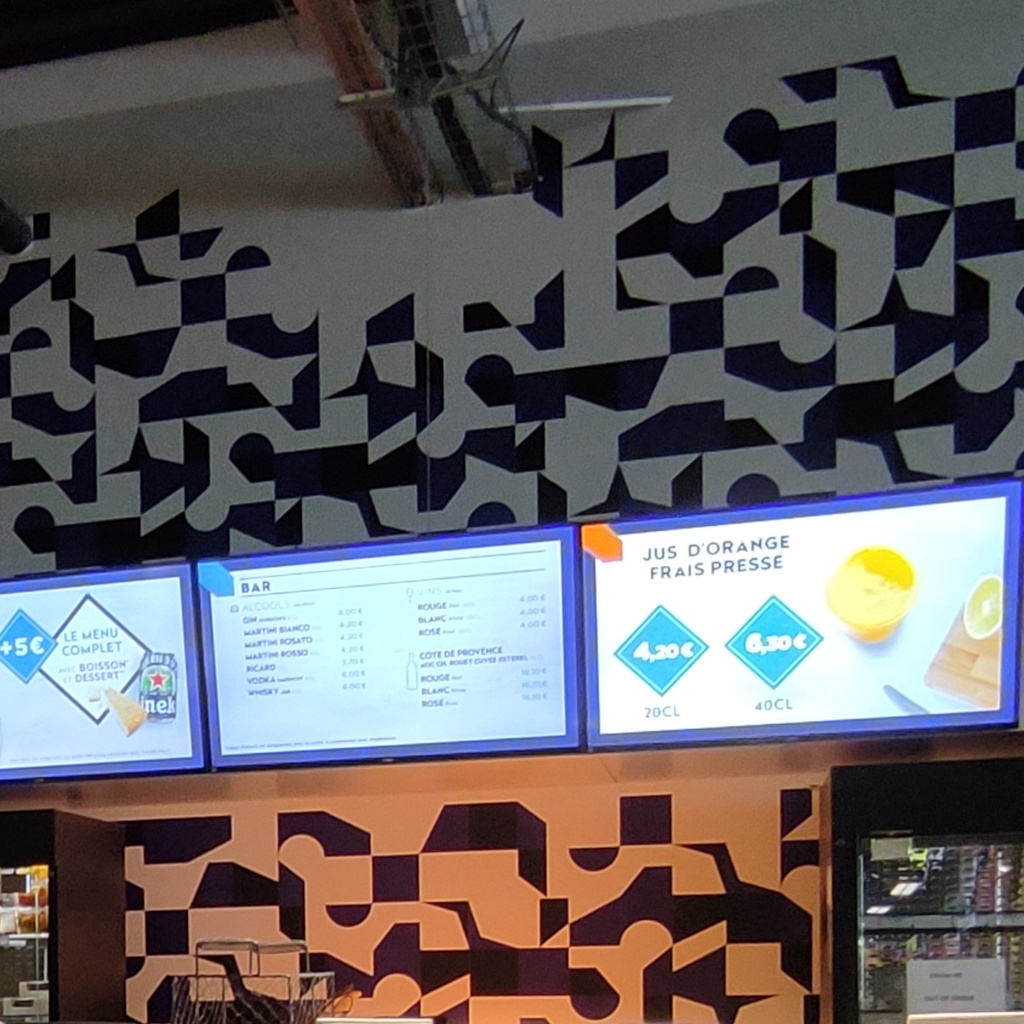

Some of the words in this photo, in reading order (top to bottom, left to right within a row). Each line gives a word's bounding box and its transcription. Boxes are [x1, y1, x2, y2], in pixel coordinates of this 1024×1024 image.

[643, 545, 677, 562] JUS
[688, 535, 790, 557] D'ORANGE
[650, 562, 705, 580] FRAIS
[241, 581, 271, 593] BAR
[242, 600, 290, 611] ALCOOLS
[418, 602, 447, 610] ROUGE
[418, 615, 447, 624] BLANC
[64, 631, 78, 642] LE
[82, 628, 118, 640] MENU
[244, 627, 277, 636] MARTINI
[279, 624, 310, 633] BIANCO
[0, 636, 45, 656] +5€
[245, 639, 278, 648] MARTINI
[280, 636, 313, 645] ROSATO
[61, 641, 122, 656] COMPLET
[246, 651, 278, 660] MARTINI
[281, 648, 308, 658] ROSSO
[444, 650, 455, 658] DE
[457, 646, 503, 657] PROVENCE
[79, 660, 126, 673] BOISSON
[75, 671, 119, 683] DESSERT
[247, 677, 276, 685] VODKA
[421, 674, 450, 683] ROUGE
[421, 687, 450, 695] BLANC
[754, 698, 794, 711] 40CL
[644, 705, 681, 719] 20CL
